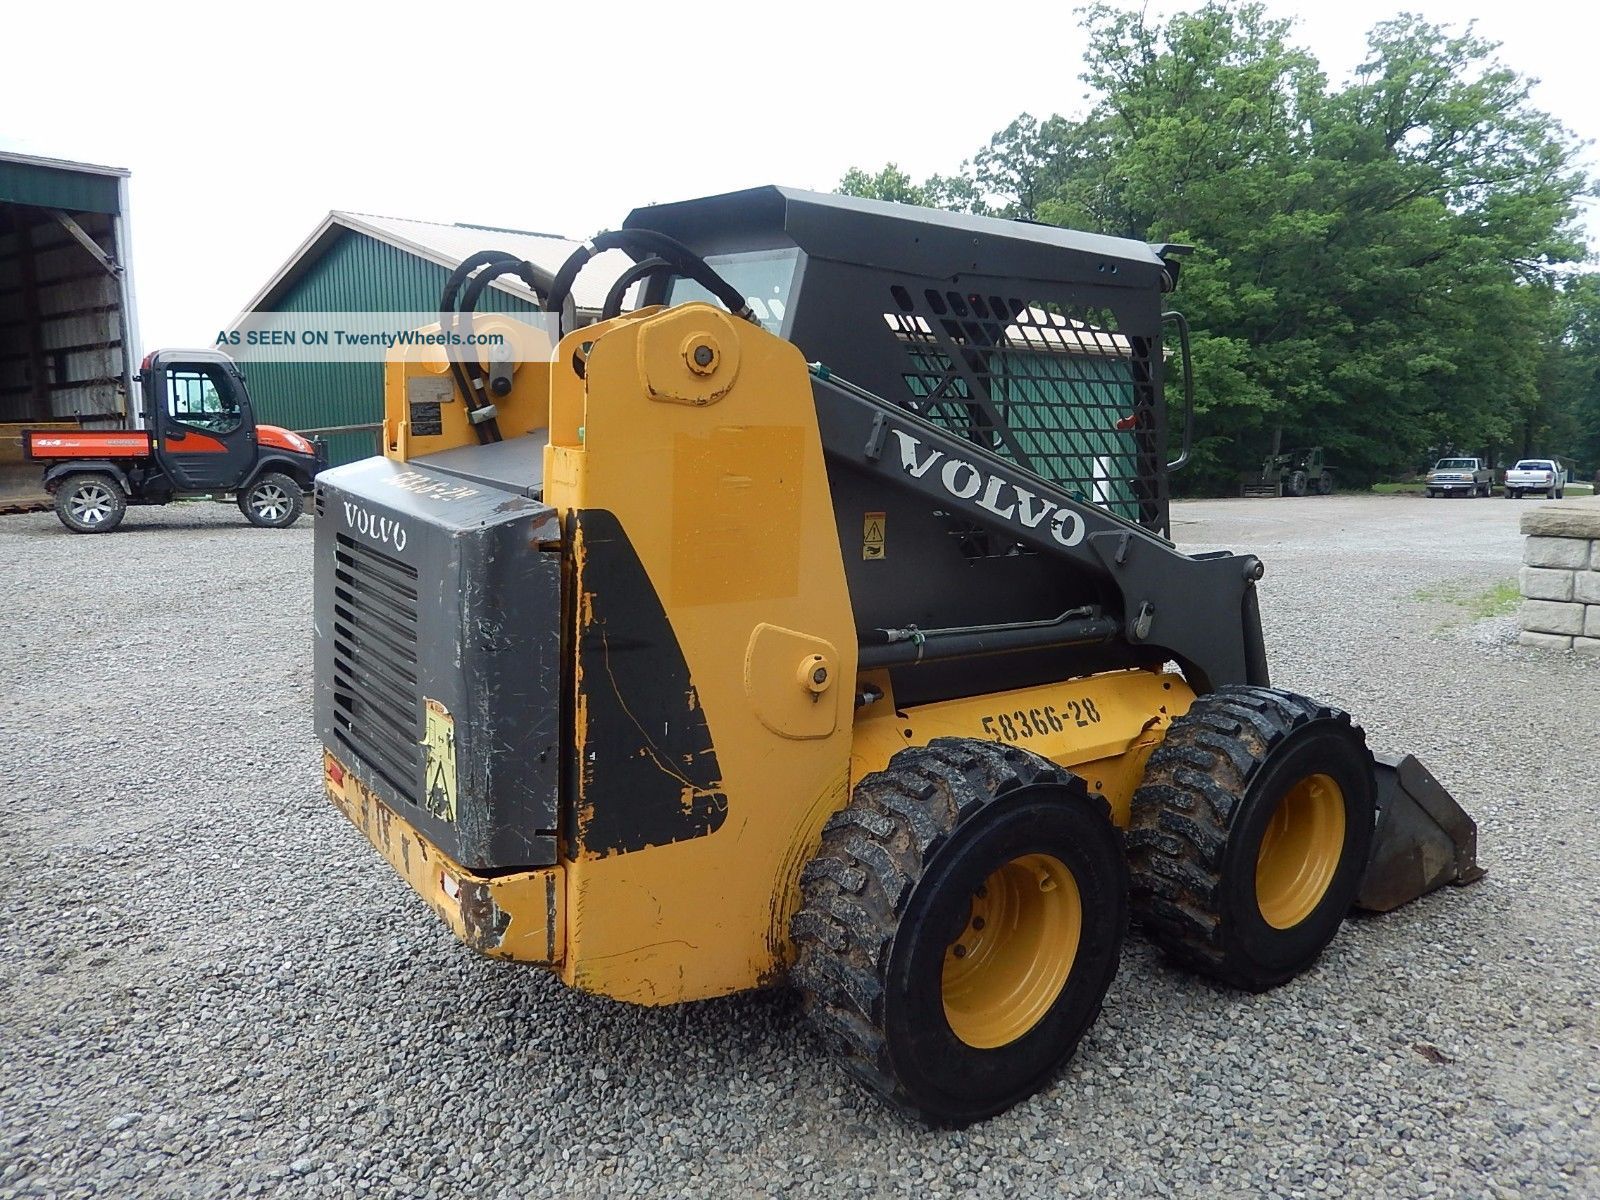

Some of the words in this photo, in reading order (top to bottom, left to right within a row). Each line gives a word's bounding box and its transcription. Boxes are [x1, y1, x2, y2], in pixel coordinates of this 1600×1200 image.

[891, 428, 1086, 547] VOLVO
[343, 501, 407, 552] VOLVO
[981, 697, 1101, 743] 58366-28
